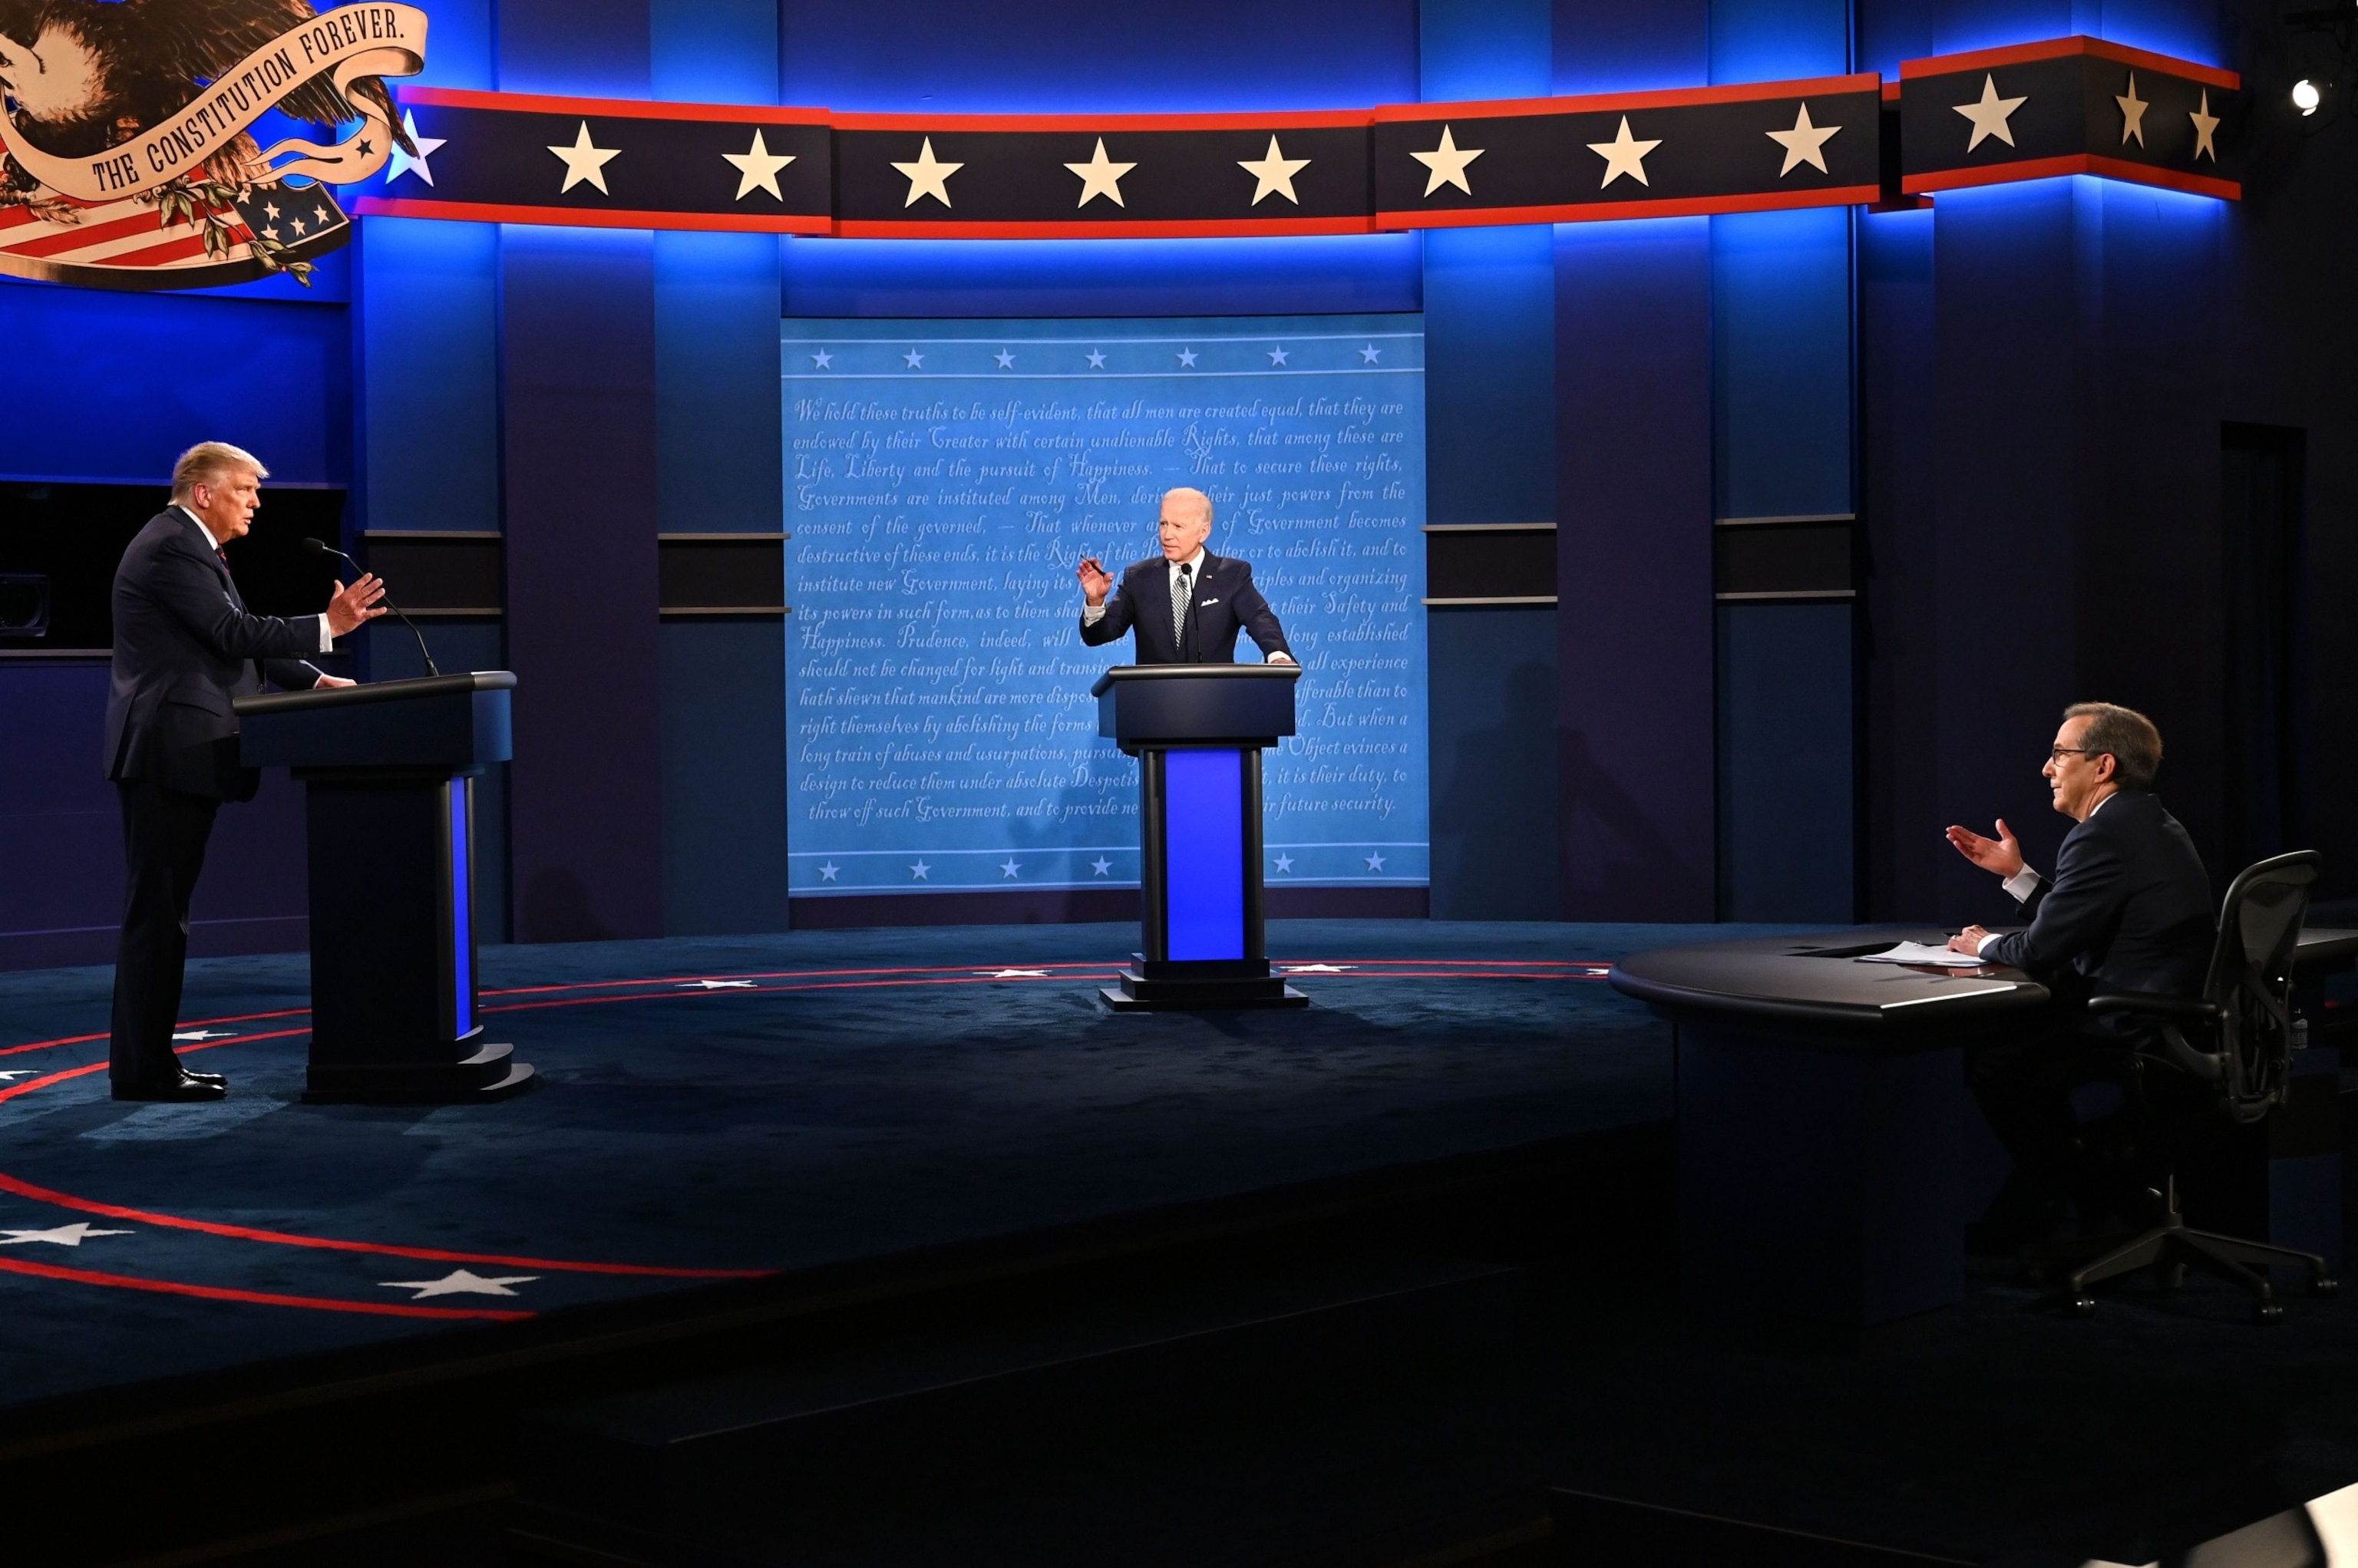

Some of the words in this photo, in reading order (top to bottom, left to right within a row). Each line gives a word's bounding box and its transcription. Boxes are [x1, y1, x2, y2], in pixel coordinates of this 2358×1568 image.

[92, 153, 140, 192] THE
[146, 48, 298, 173] CONSTITUTION
[298, 8, 405, 64] FOREVER.
[794, 398, 822, 421] We
[824, 401, 860, 420] hold
[860, 402, 897, 421] these
[902, 401, 948, 420] truths
[953, 406, 966, 420] to
[970, 402, 985, 420] be
[989, 401, 1080, 428] self-evident,
[1087, 401, 1118, 420] that
[1122, 400, 1144, 419] all
[1145, 408, 1174, 418] men
[1179, 408, 1200, 418] are
[1205, 399, 1261, 418] created
[1262, 397, 1303, 426] equal,
[1309, 397, 1339, 416] that
[1344, 396, 1376, 425] they
[1381, 404, 1402, 414] are
[794, 431, 859, 450] endowed
[861, 431, 880, 458] by
[887, 430, 921, 449] their
[928, 426, 989, 448] Creator
[996, 430, 1030, 448] with
[1034, 432, 1084, 448] certain
[1091, 427, 1174, 447] unalienable
[1181, 421, 1239, 456] Rights,
[1248, 426, 1278, 445] that
[1285, 434, 1330, 452] among
[1337, 424, 1374, 444] these
[1381, 432, 1403, 442] are
[794, 454, 834, 486] Life,
[845, 454, 905, 486] Liberty
[914, 459, 944, 477] and
[949, 457, 971, 477] the
[975, 460, 1035, 484] pursuit
[1044, 457, 1062, 485] of
[1068, 450, 1152, 484] Happiness.
[1189, 454, 1225, 474] That
[1233, 460, 1247, 474] to
[1256, 462, 1302, 474] secure
[1310, 454, 1347, 473] these
[1356, 453, 1402, 480] rights,
[797, 484, 898, 510] Governments
[907, 495, 929, 505] are
[938, 487, 1015, 505] instituted
[1020, 494, 1065, 513] among
[1075, 482, 1120, 505] Men,
[1239, 484, 1272, 510] just
[1277, 489, 1331, 510] powers
[1336, 481, 1373, 509] from
[1383, 480, 1405, 500] the
[797, 520, 852, 534] consent
[862, 514, 880, 543] of
[887, 514, 908, 533] the
[913, 515, 986, 542] governed,
[1025, 510, 1061, 533] That
[1072, 514, 1136, 533] whenever
[1222, 512, 1240, 540] of
[1247, 508, 1339, 534] Government
[1349, 510, 1406, 528] becomes
[798, 545, 880, 563] destructive
[884, 543, 903, 571] of
[903, 543, 940, 562] these
[944, 543, 979, 563] ends,
[986, 546, 997, 562] it
[1002, 545, 1014, 561] is
[1018, 543, 1039, 562] the
[1249, 549, 1263, 558] or
[1268, 544, 1281, 559] to
[1286, 537, 1339, 557] abolish
[1341, 540, 1356, 557] it,
[1362, 538, 1393, 556] and
[1393, 543, 1406, 556] to
[798, 576, 863, 592] institute
[867, 579, 897, 591] new
[901, 568, 997, 595] Government,
[1003, 571, 1049, 600] laying
[1054, 573, 1073, 589] its
[1299, 567, 1329, 586] and
[1329, 568, 1407, 593] organizing
[798, 604, 818, 621] its
[816, 607, 873, 629] powers
[877, 603, 892, 619] in
[897, 600, 934, 619] such
[996, 605, 1009, 619] to
[1015, 599, 1049, 619] them
[1281, 596, 1316, 615] their
[1322, 591, 1376, 620] Safety
[1382, 594, 1412, 612] and
[801, 625, 885, 657] Happiness.
[897, 622, 969, 649] Prudence,
[980, 629, 1031, 649] indeed,
[1043, 627, 1074, 647] will
[1328, 622, 1412, 642] established
[798, 657, 852, 677] should
[853, 663, 877, 676] not
[880, 659, 896, 676] be
[900, 657, 963, 685] changed
[961, 657, 986, 683] for
[989, 657, 1024, 685] light
[1029, 657, 1059, 675] and
[1308, 651, 1329, 670] all
[1331, 653, 1408, 678] experience
[800, 687, 836, 706] hath
[837, 687, 880, 705] shewn
[884, 687, 915, 705] that
[918, 686, 985, 706] mankind
[984, 694, 1006, 705] are
[1009, 694, 1043, 704] more
[1357, 679, 1390, 698] than
[1394, 684, 1407, 698] to
[800, 715, 837, 743] right
[840, 714, 920, 734] themselves
[923, 715, 941, 742] by
[946, 714, 1019, 741] abolishing
[1025, 713, 1046, 732] the
[1046, 712, 1092, 741] forms
[1316, 702, 1353, 728] But
[1359, 707, 1394, 726] when
[1399, 715, 1408, 725] a
[800, 743, 831, 771] long
[835, 745, 870, 762] train
[875, 742, 894, 770] of
[894, 744, 942, 761] abuses
[946, 743, 976, 761] and
[976, 744, 1067, 768] usurpations,
[1288, 732, 1340, 762] Object
[1343, 738, 1396, 754] evinces
[1400, 743, 1408, 754] a
[801, 773, 847, 800] design
[851, 777, 864, 791] to
[869, 771, 916, 790] reduce
[920, 771, 955, 790] them
[960, 771, 1002, 789] under
[1006, 768, 1065, 789] absolute
[1278, 767, 1290, 784] it
[1293, 767, 1306, 783] is
[1310, 764, 1345, 784] their
[1349, 764, 1386, 793] duty,
[1393, 768, 1407, 782] to
[809, 801, 851, 820] throw
[854, 798, 877, 827] off
[876, 800, 913, 818] such
[916, 796, 1010, 822] Government,
[1016, 798, 1047, 816] and
[1047, 802, 1058, 816] to
[1059, 797, 1118, 824] provide
[1275, 792, 1328, 820] future
[1332, 794, 1395, 820] security.
